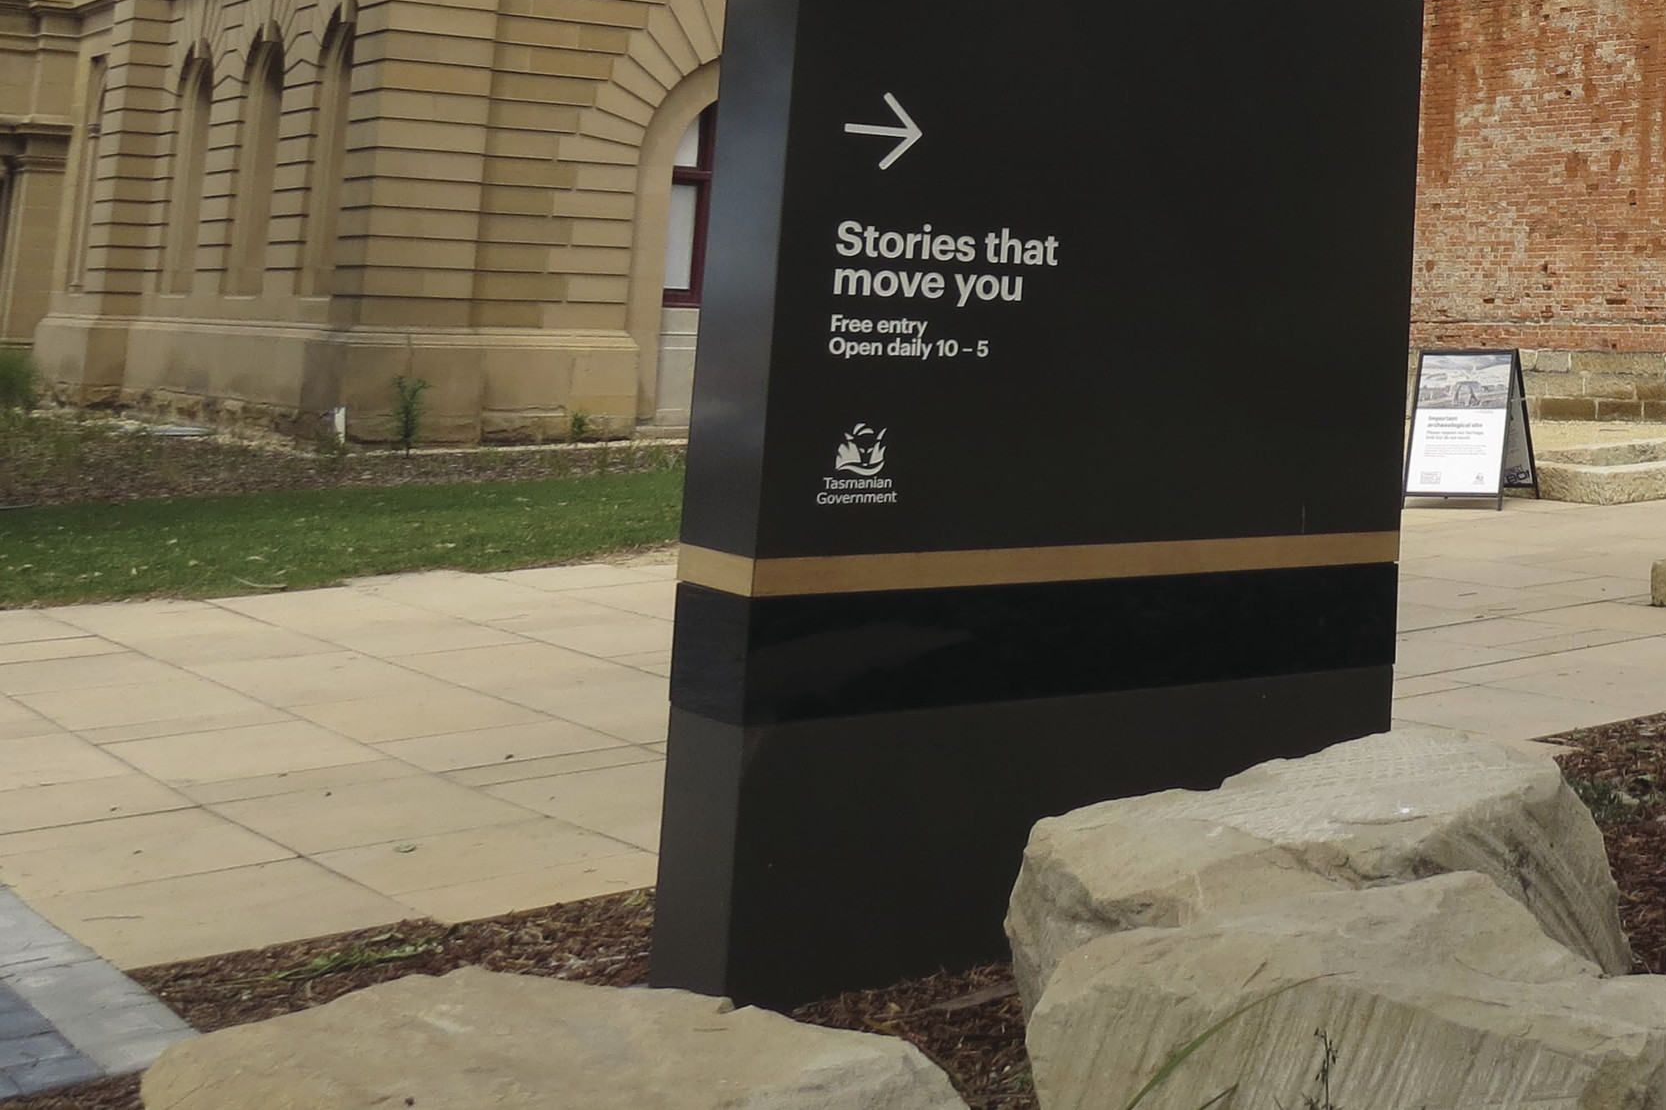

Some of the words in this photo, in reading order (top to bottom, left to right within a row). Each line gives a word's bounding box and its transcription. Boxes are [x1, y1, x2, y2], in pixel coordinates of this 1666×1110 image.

[835, 220, 976, 263] Stories
[984, 227, 1060, 267] that
[832, 268, 946, 299] move
[954, 273, 1024, 308] you
[829, 313, 874, 334] Free
[876, 317, 929, 338] entry
[828, 336, 883, 360] Open
[887, 337, 932, 361] daily
[935, 339, 959, 358] 10
[976, 339, 989, 358] 5
[822, 475, 893, 490] Tasmanian
[816, 490, 898, 505] Government
